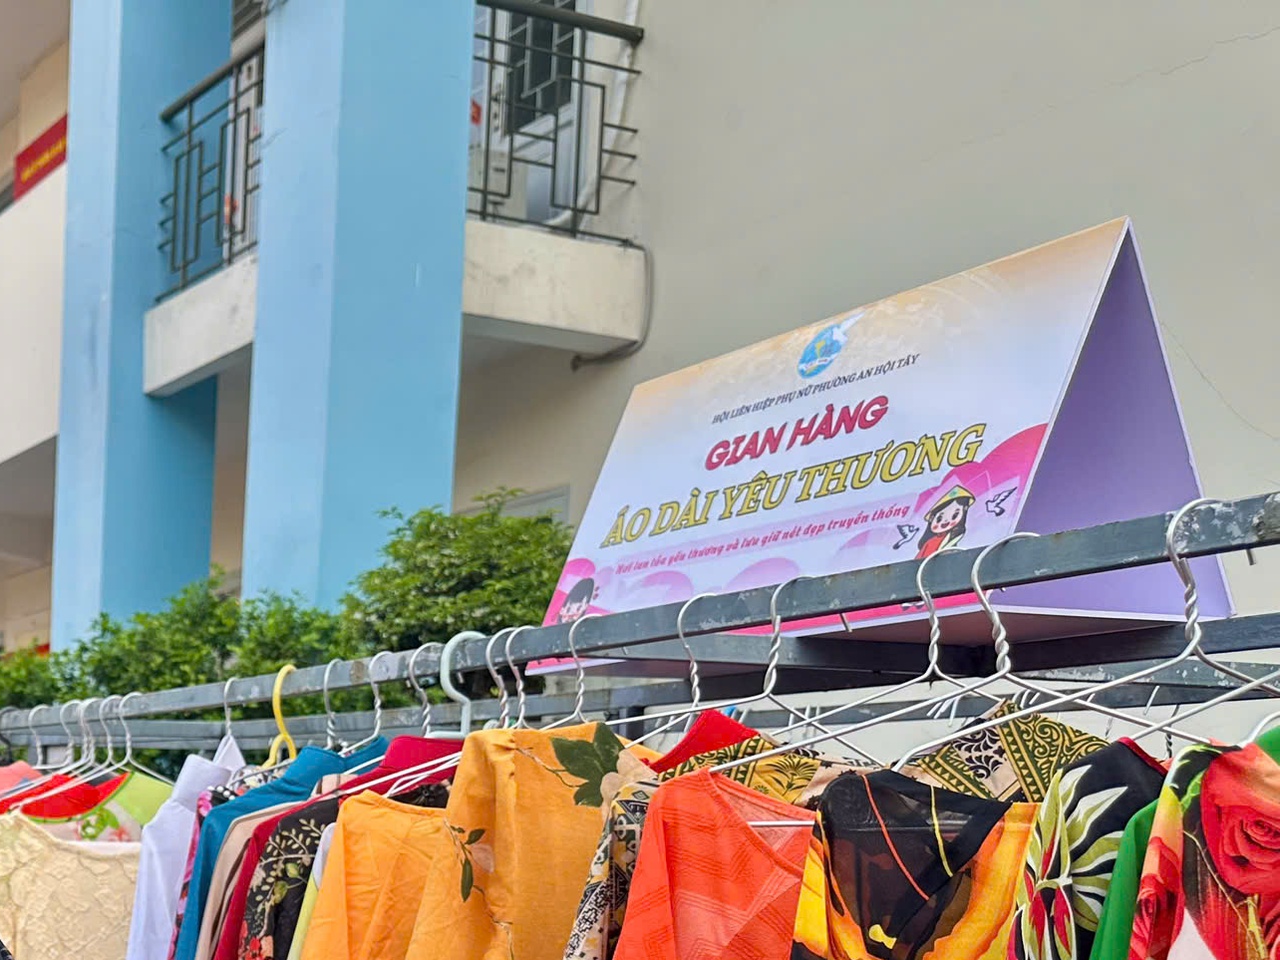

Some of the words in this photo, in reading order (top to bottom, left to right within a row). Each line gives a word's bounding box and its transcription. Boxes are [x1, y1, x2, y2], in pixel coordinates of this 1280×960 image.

[775, 390, 797, 405] PHỤ
[856, 367, 874, 380] AN
[873, 359, 896, 375] HỘI
[896, 353, 920, 369] TÂY
[705, 422, 788, 471] GIAN
[786, 395, 889, 451] HÀNG
[599, 505, 651, 548] ÁO
[649, 487, 718, 537] DÀI
[718, 470, 797, 521] YÊU
[794, 423, 987, 504] THƯƠNG
[725, 538, 740, 551] và
[782, 525, 802, 540] nét
[802, 523, 825, 538] đẹp
[827, 510, 870, 530] truyền
[871, 503, 911, 523] thống
